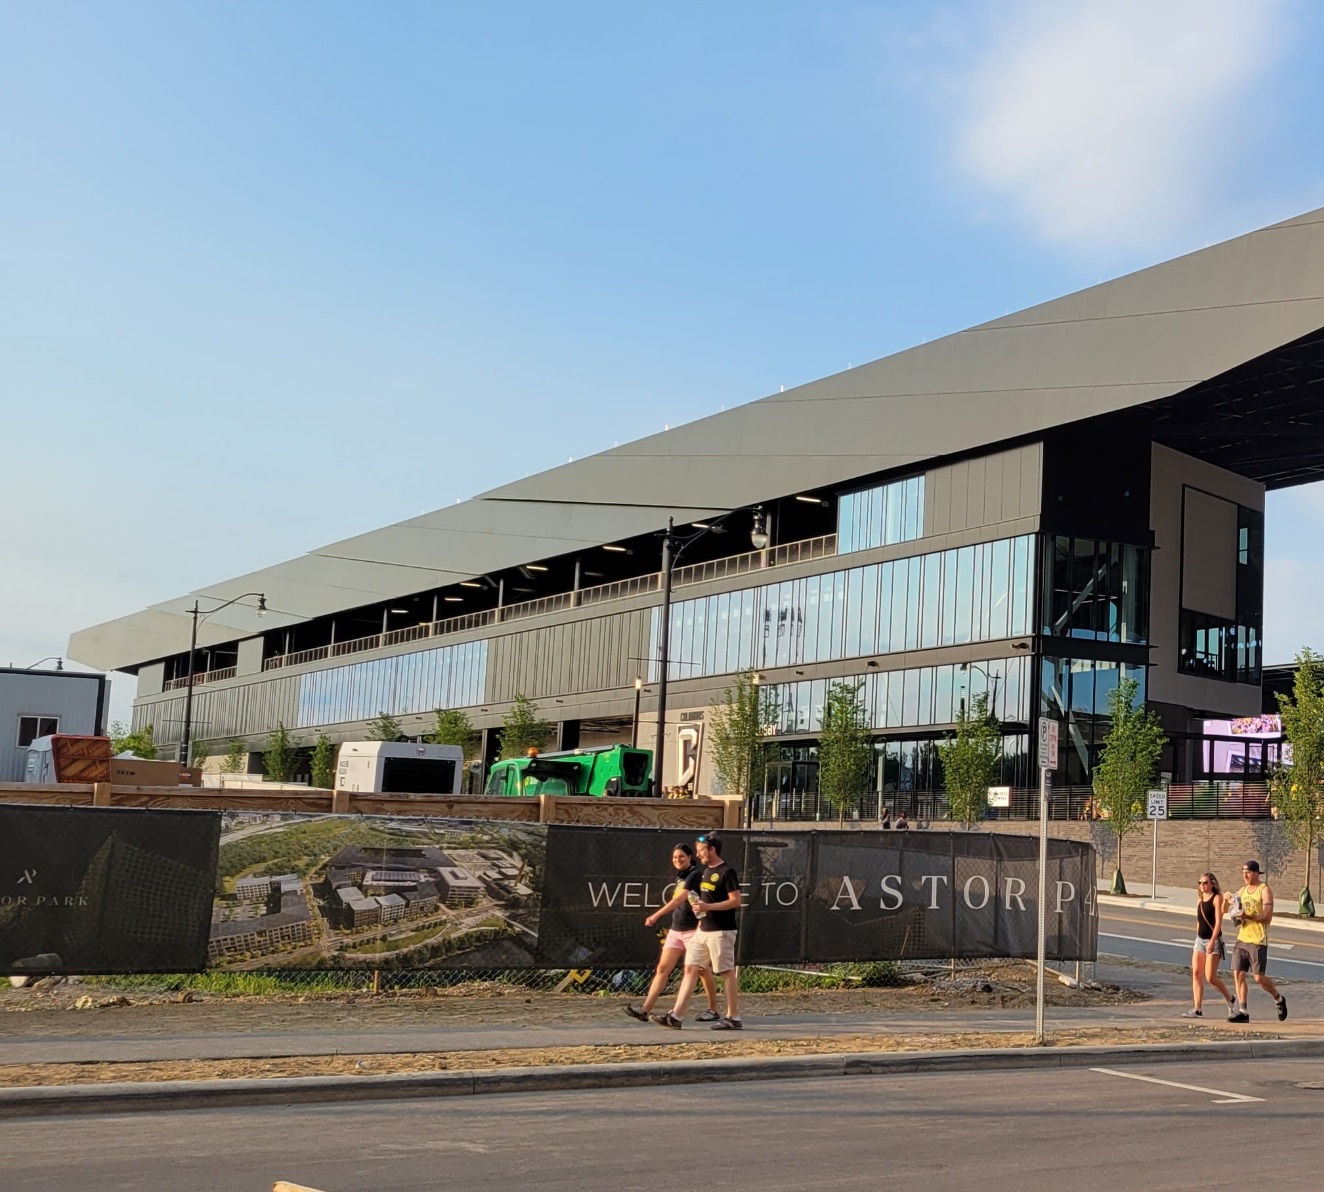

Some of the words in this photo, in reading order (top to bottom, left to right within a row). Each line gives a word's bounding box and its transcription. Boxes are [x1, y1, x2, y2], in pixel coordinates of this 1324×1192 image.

[1149, 805, 1165, 816] 25
[36, 896, 89, 906] PARK
[588, 881, 751, 908] WELCE
[761, 881, 799, 906] TO
[829, 874, 1027, 911] ASTOR
